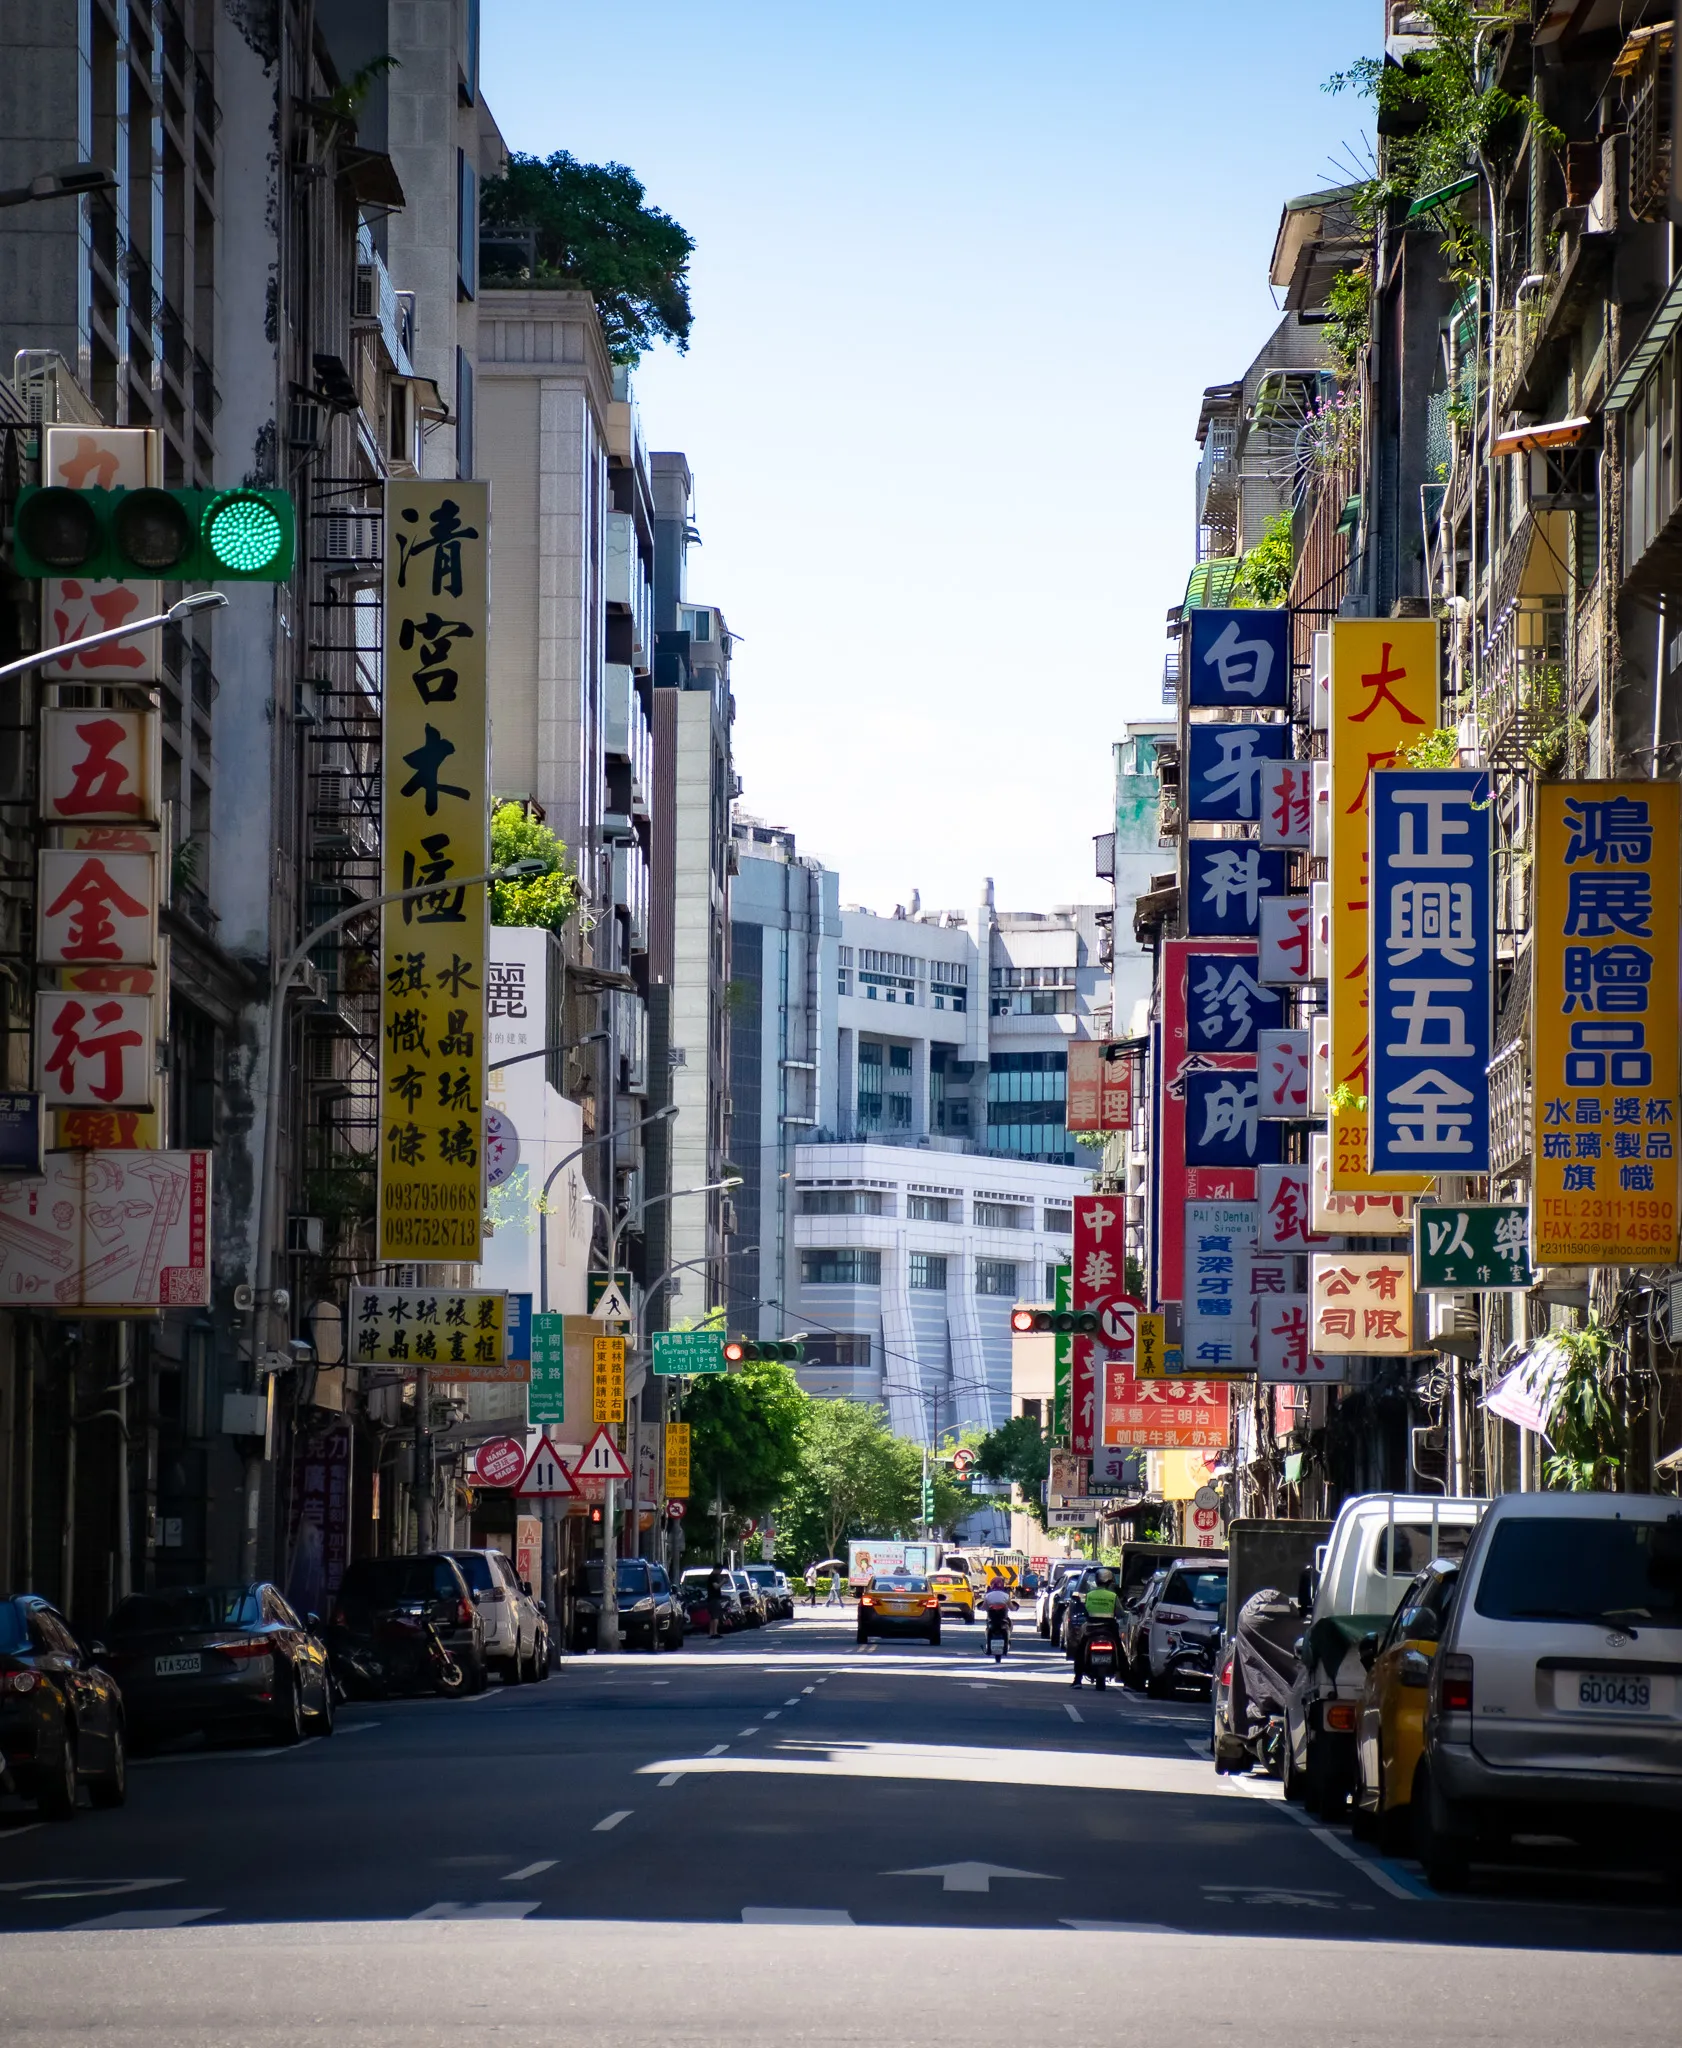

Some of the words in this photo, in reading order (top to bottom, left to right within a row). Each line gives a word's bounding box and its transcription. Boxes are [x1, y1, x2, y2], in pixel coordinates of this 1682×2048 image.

[1200, 620, 1281, 1158] 白牙科診所
[1562, 796, 1654, 1087] 鴻展贈品
[1386, 789, 1476, 1153] 正興五金
[386, 951, 431, 1168] 旗幟布條
[436, 952, 480, 1169] 水晶琉璃
[385, 1182, 476, 1212] 0937950668
[1543, 1199, 1577, 1217] TEL:
[385, 1217, 476, 1246] 0937528713
[1214, 1225, 1242, 1233] Since
[1223, 1211, 1254, 1223] Dental
[1444, 1264, 1525, 1283] 工作室
[485, 1448, 507, 1463] HAND
[494, 1464, 516, 1481] MADE
